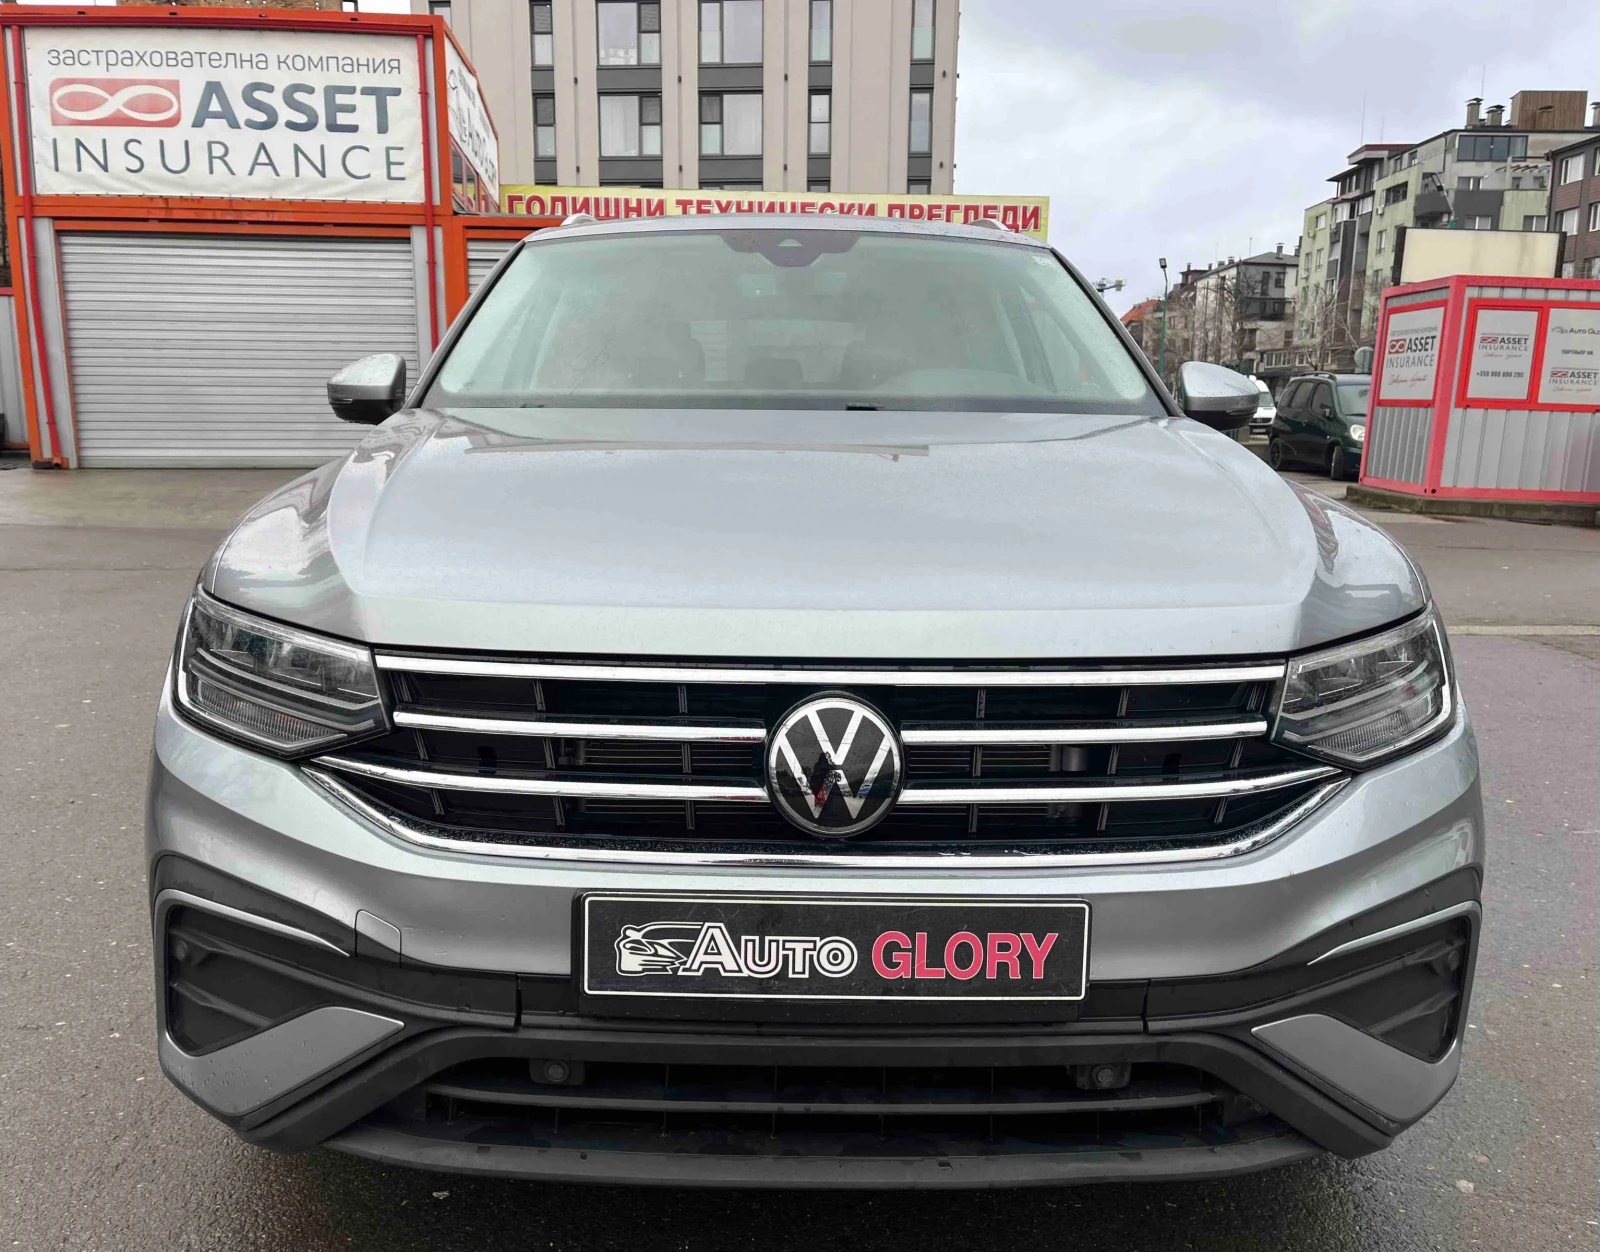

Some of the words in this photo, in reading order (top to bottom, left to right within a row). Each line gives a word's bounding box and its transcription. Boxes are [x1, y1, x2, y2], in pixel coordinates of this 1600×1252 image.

[47, 49, 268, 72] застрахователна
[277, 53, 401, 75] компания
[191, 80, 402, 134] ASSET
[52, 137, 406, 181] INSURANCE
[506, 194, 665, 219] ГОДИШНИ
[1406, 336, 1437, 353] ASSET
[1499, 337, 1529, 345] ASSET
[1386, 355, 1435, 368] INSURANCE
[1549, 378, 1598, 386] INSURANCE
[1569, 371, 1599, 379] ASSET
[871, 930, 1058, 980] GLORY
